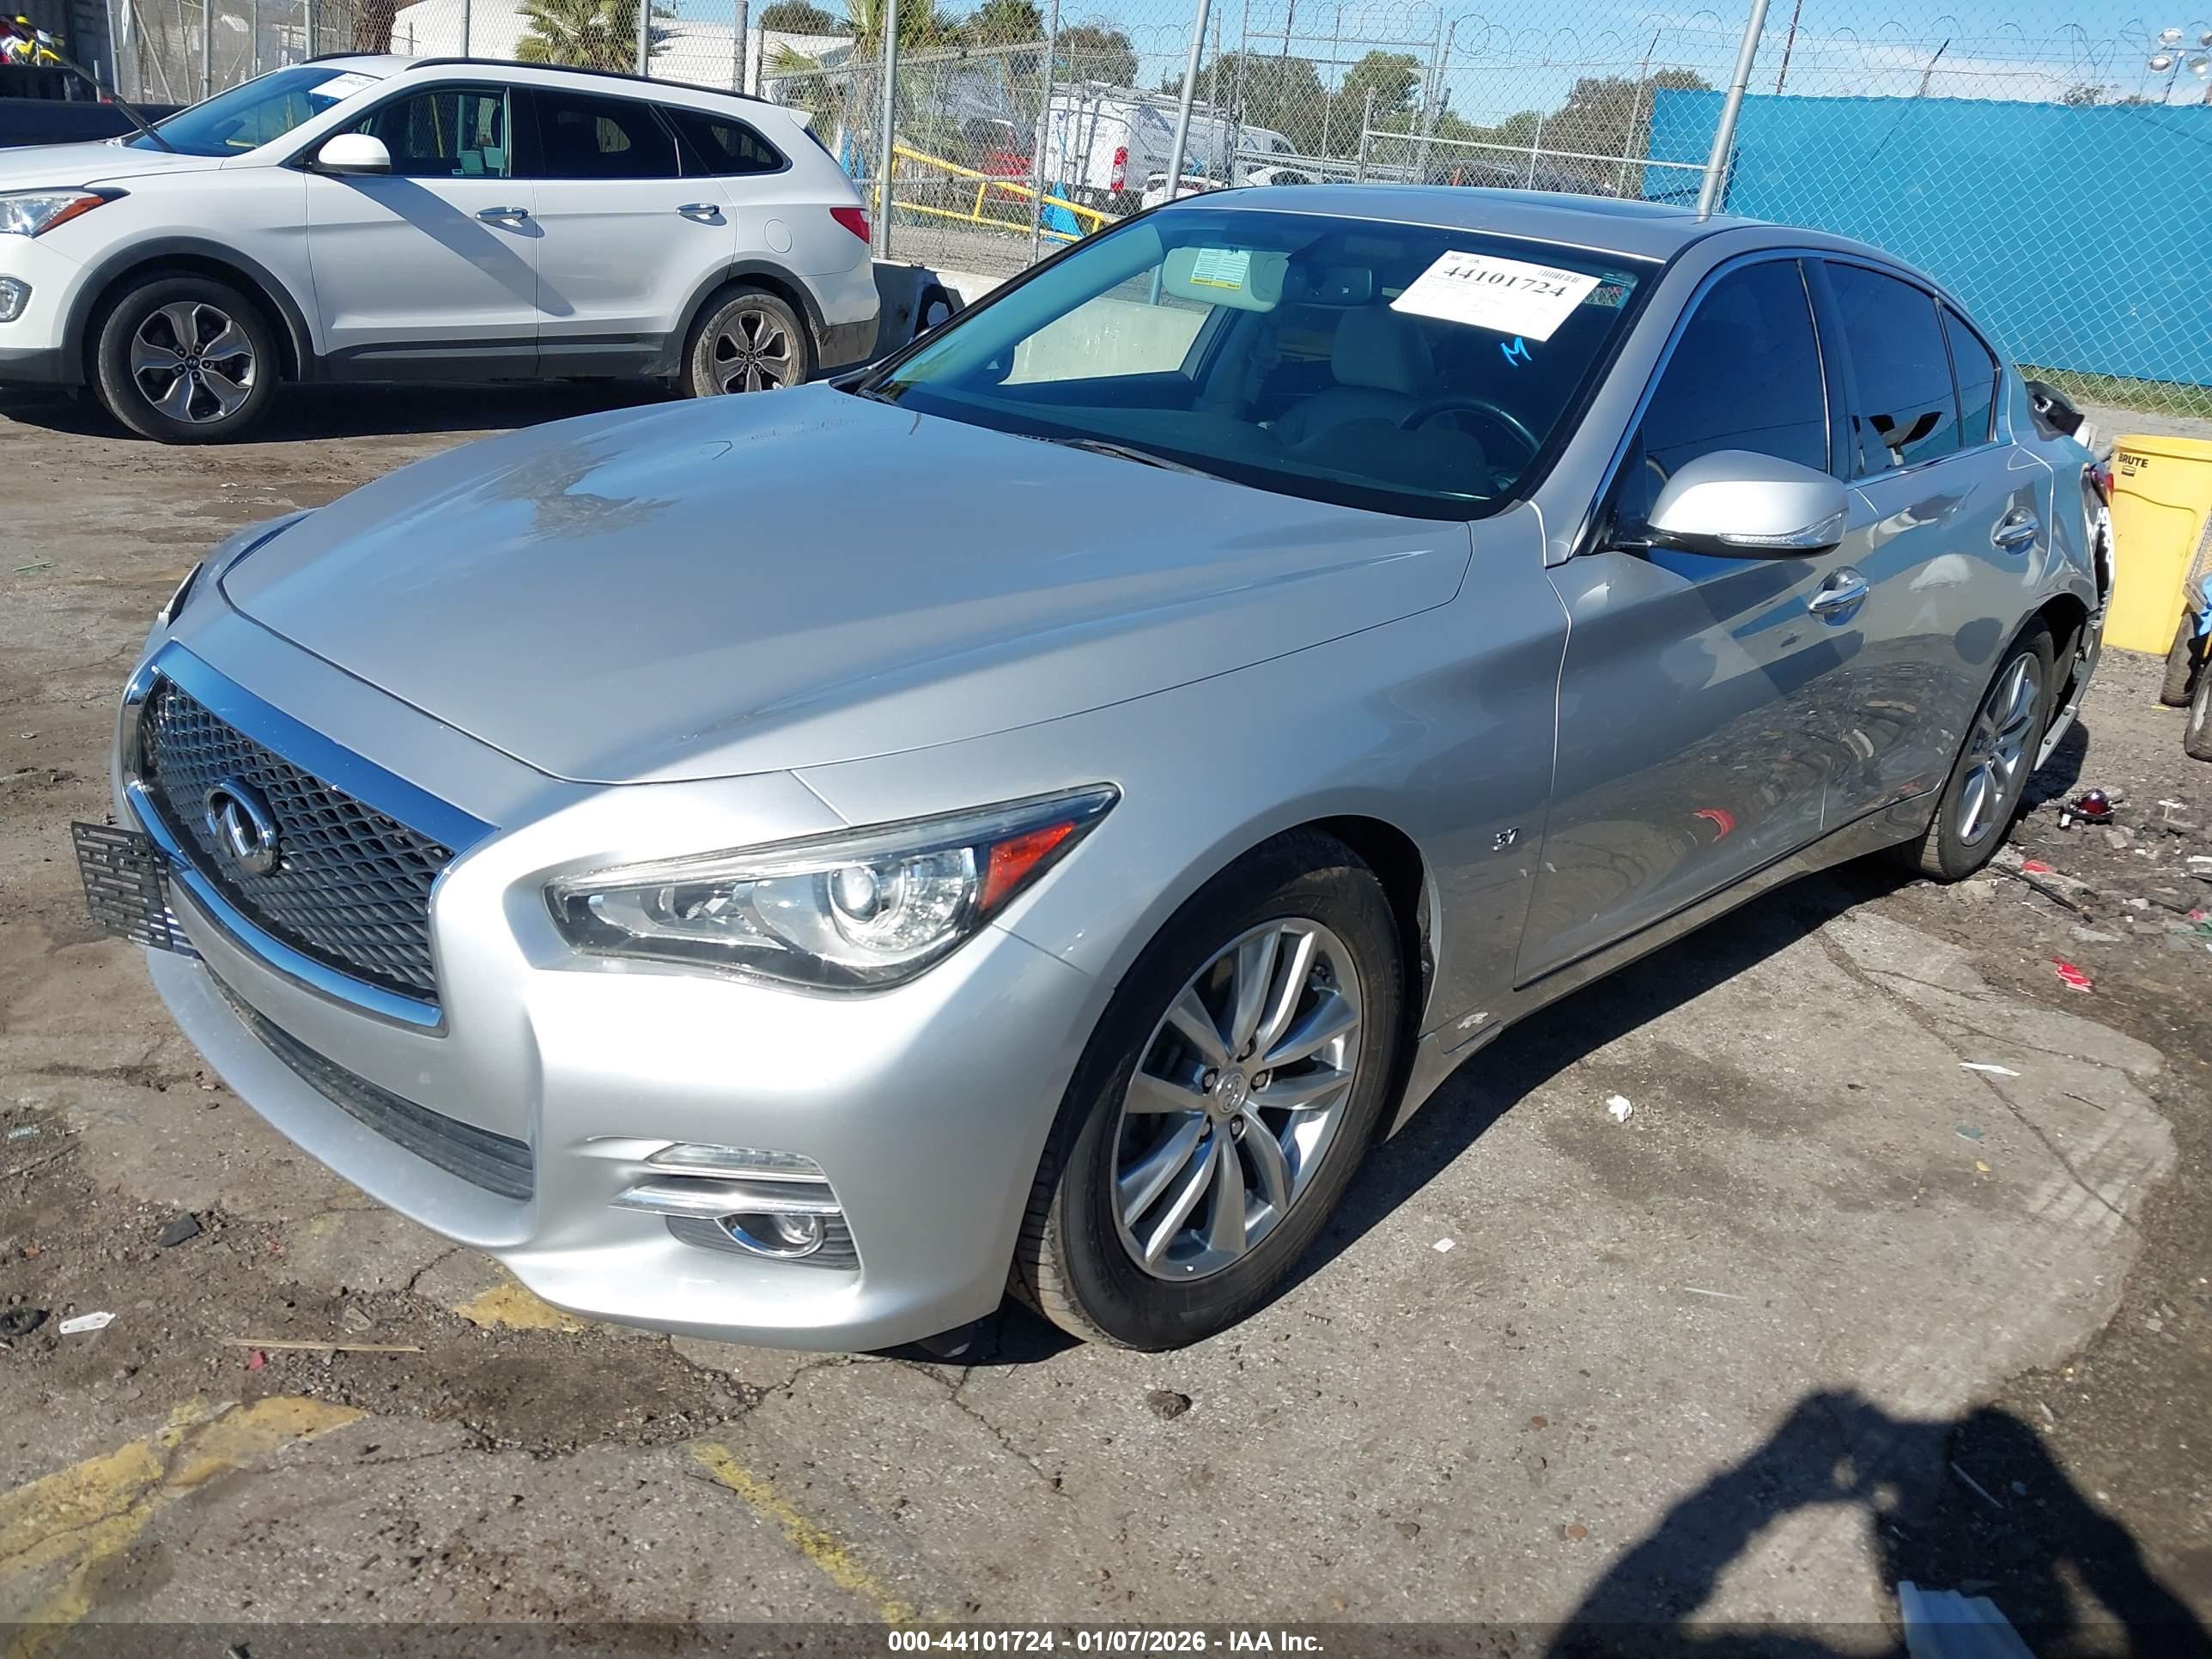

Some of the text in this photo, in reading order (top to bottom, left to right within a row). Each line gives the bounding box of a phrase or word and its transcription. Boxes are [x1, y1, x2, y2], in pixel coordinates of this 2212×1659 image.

[1443, 265, 1568, 297] 44101724
[1499, 336, 1533, 368] M
[2118, 453, 2149, 468] BRUTE
